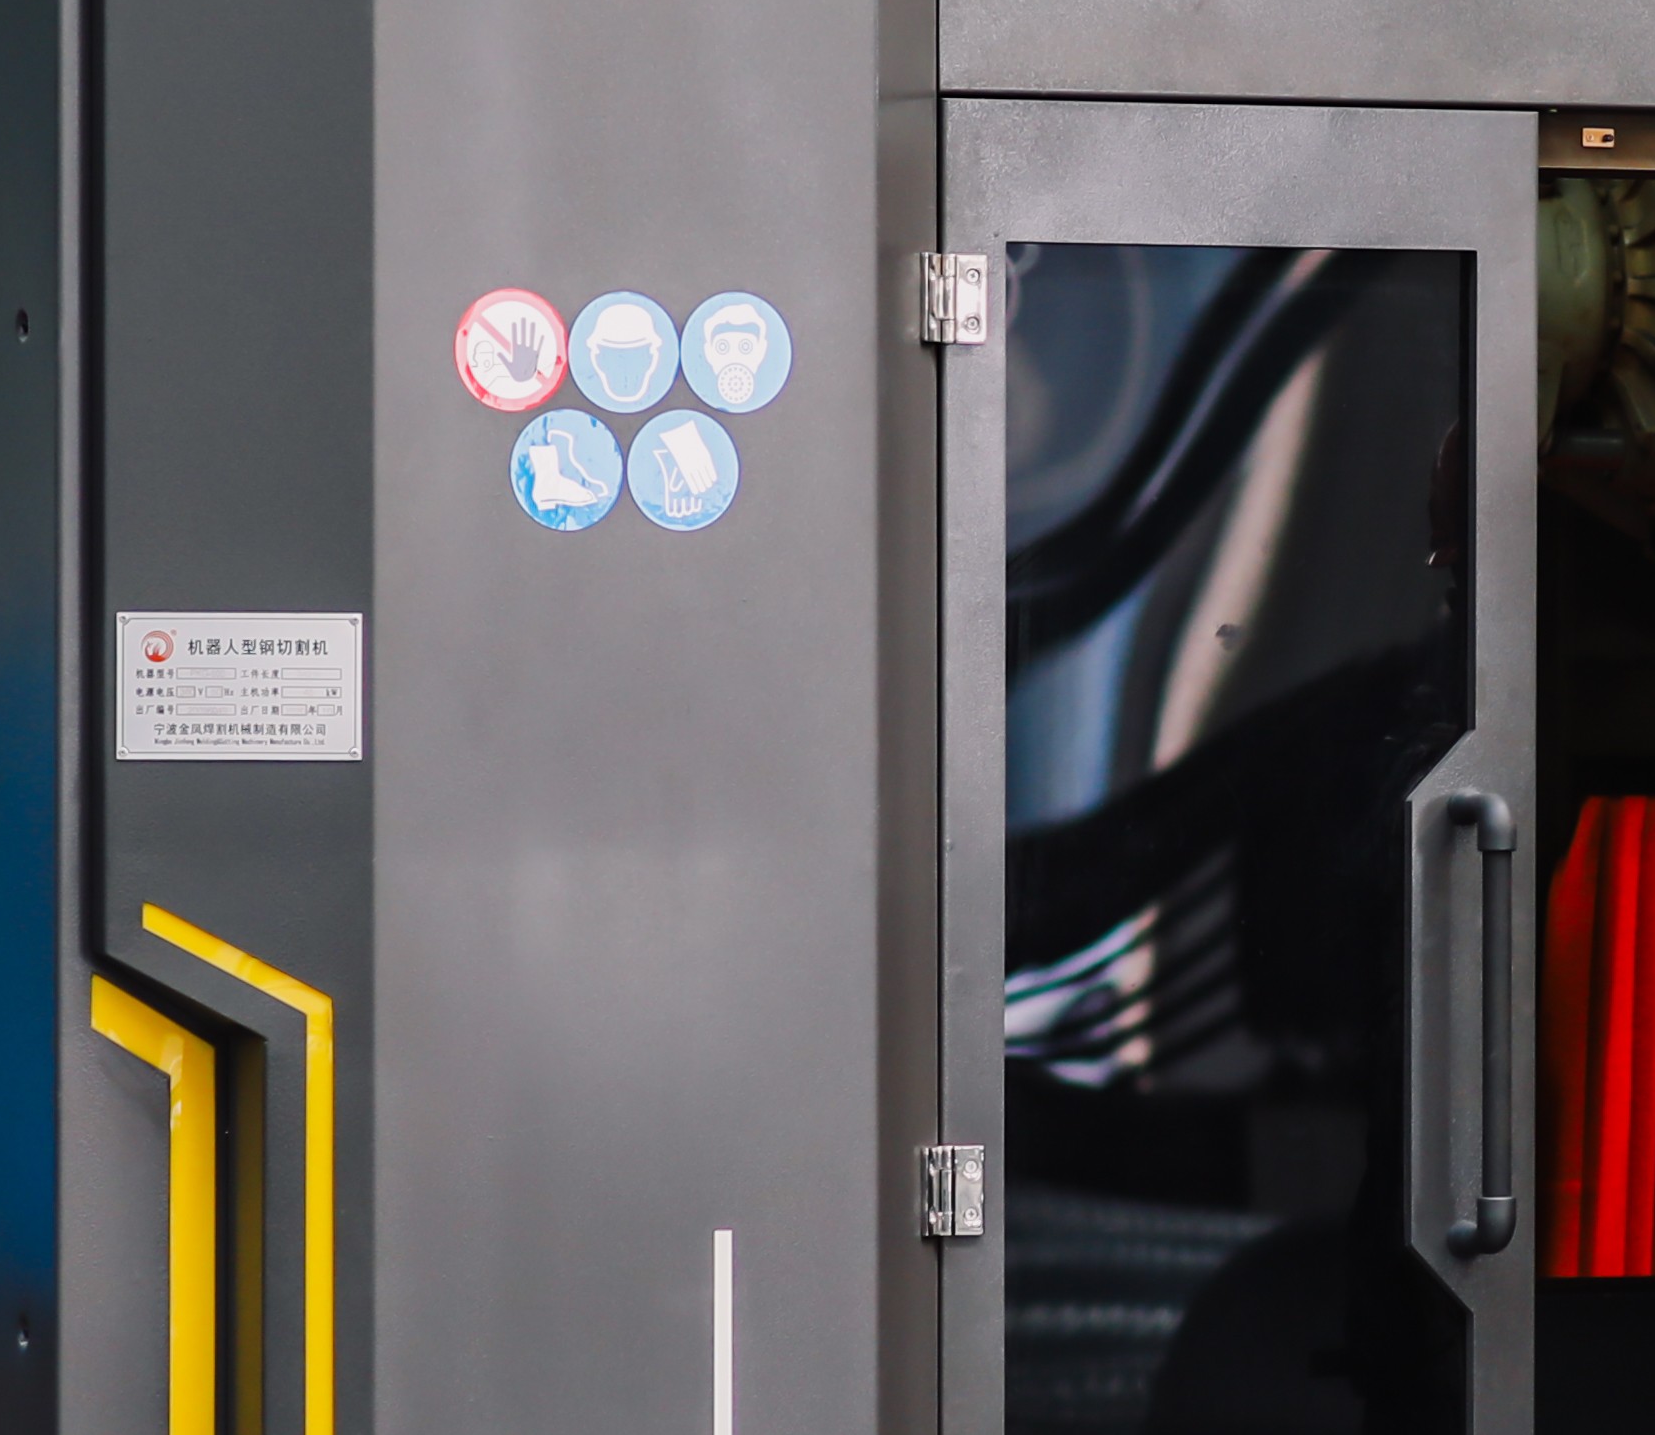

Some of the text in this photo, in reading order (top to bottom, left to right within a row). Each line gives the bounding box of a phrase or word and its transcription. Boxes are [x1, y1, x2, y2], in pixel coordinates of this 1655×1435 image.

[187, 638, 329, 656] 机器人型钢切割机
